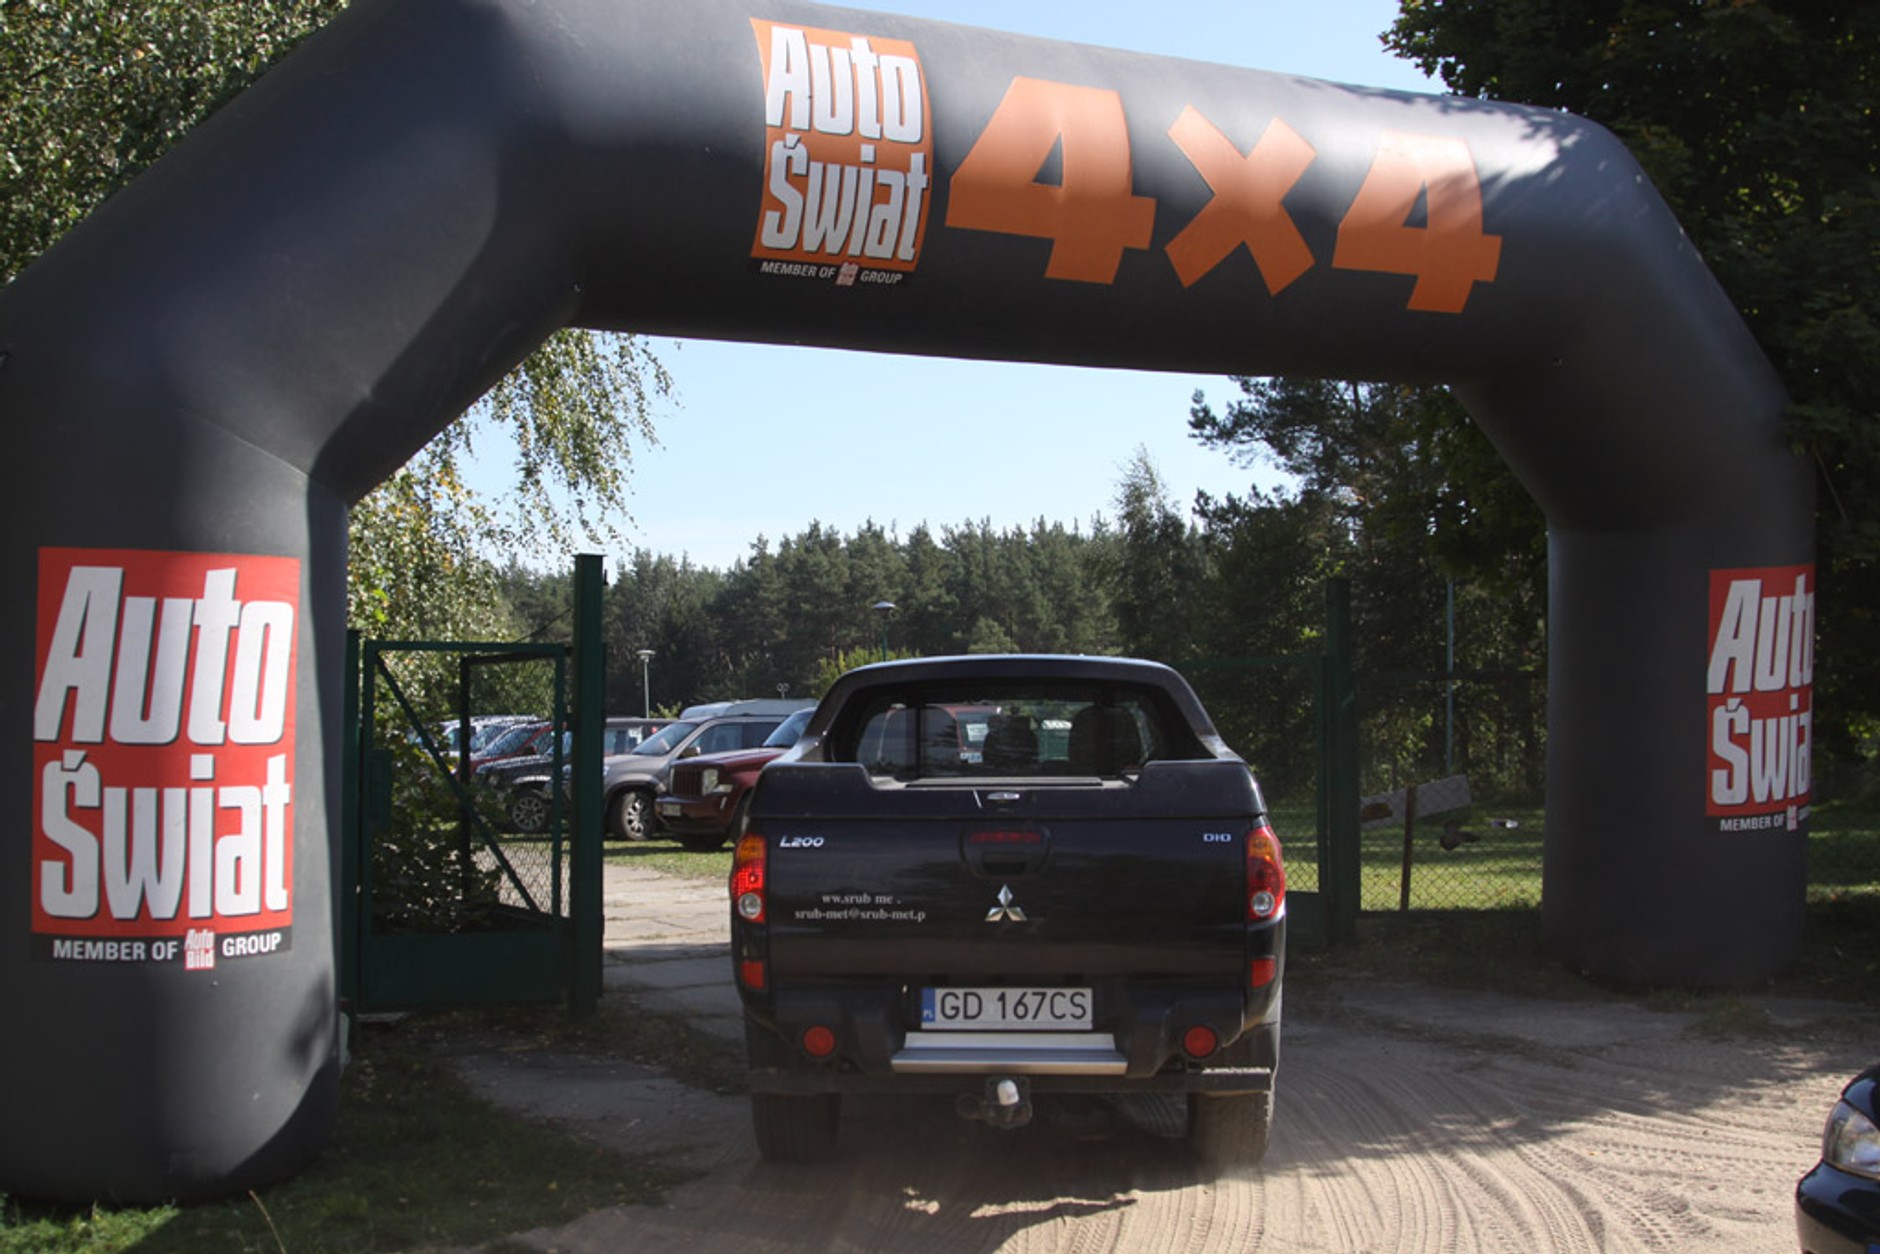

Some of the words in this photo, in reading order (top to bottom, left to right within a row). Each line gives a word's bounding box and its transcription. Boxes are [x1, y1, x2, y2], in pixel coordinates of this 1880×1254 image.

[765, 25, 923, 143] Auto
[760, 133, 929, 261] Świat
[760, 261, 817, 278] MEMBER
[818, 266, 837, 279] OF
[860, 270, 903, 285] GROUP
[33, 565, 295, 745] Auto
[1711, 691, 1812, 806] Świa
[39, 749, 292, 919] Świat
[1720, 815, 1772, 832] MEMBER
[1773, 813, 1784, 828] OF
[779, 836, 825, 848] L200
[53, 939, 146, 961] MEMBER
[151, 940, 178, 961] OF
[221, 932, 283, 957] GROUP
[940, 991, 984, 1021] GD
[996, 991, 1087, 1021] 167CS
